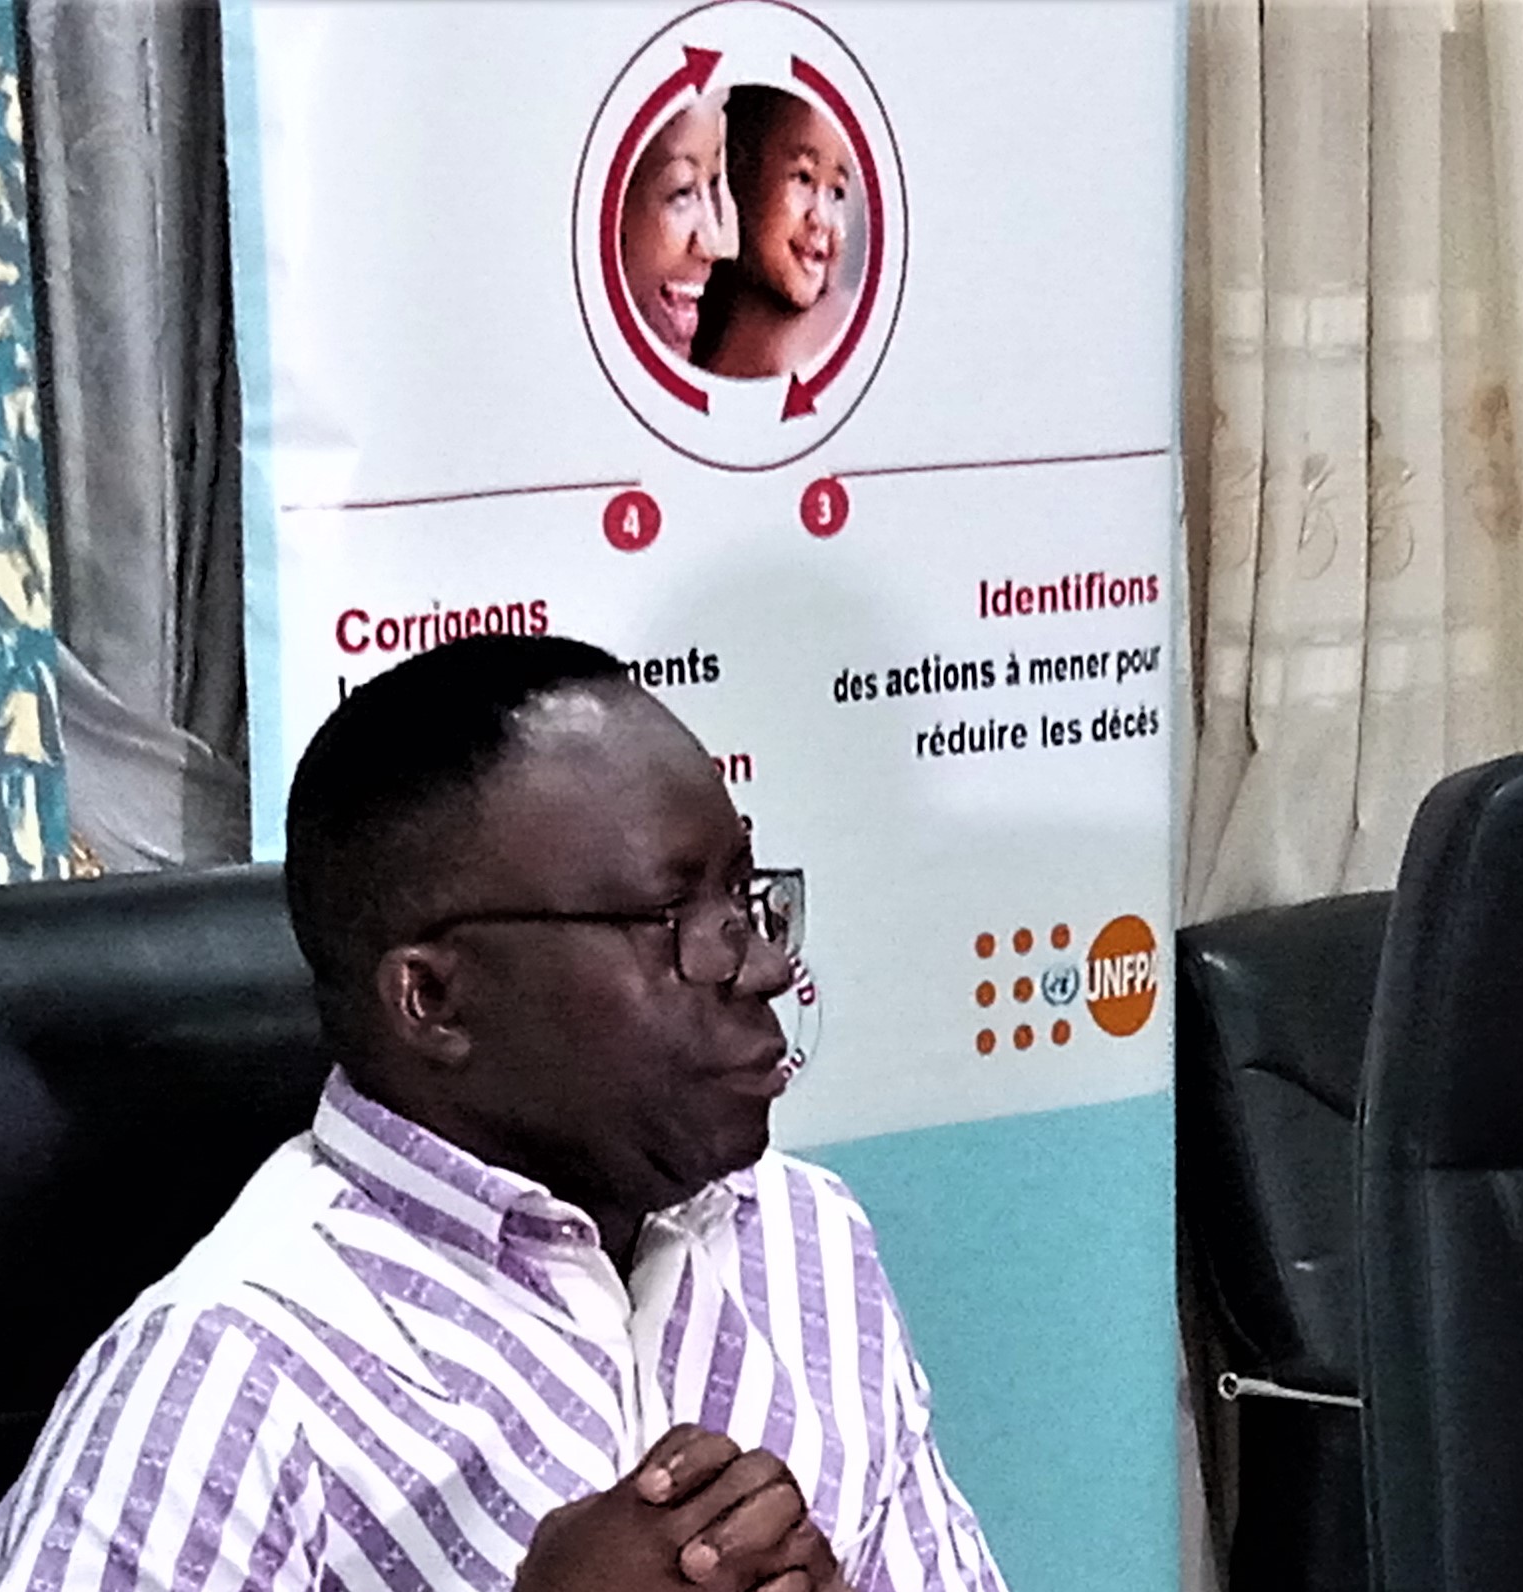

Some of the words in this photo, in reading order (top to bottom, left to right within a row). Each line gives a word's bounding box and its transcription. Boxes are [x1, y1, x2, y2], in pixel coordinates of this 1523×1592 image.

[622, 503, 640, 539] 4
[818, 491, 831, 526] 3
[979, 571, 1159, 619] Identifions
[335, 599, 549, 654] Corrigeons
[833, 668, 877, 702] des
[886, 654, 995, 698] actions
[1005, 650, 1020, 686] à
[1029, 651, 1109, 686] mener
[1116, 646, 1161, 684] pour
[917, 720, 1028, 757] réduire
[1040, 715, 1082, 748] les
